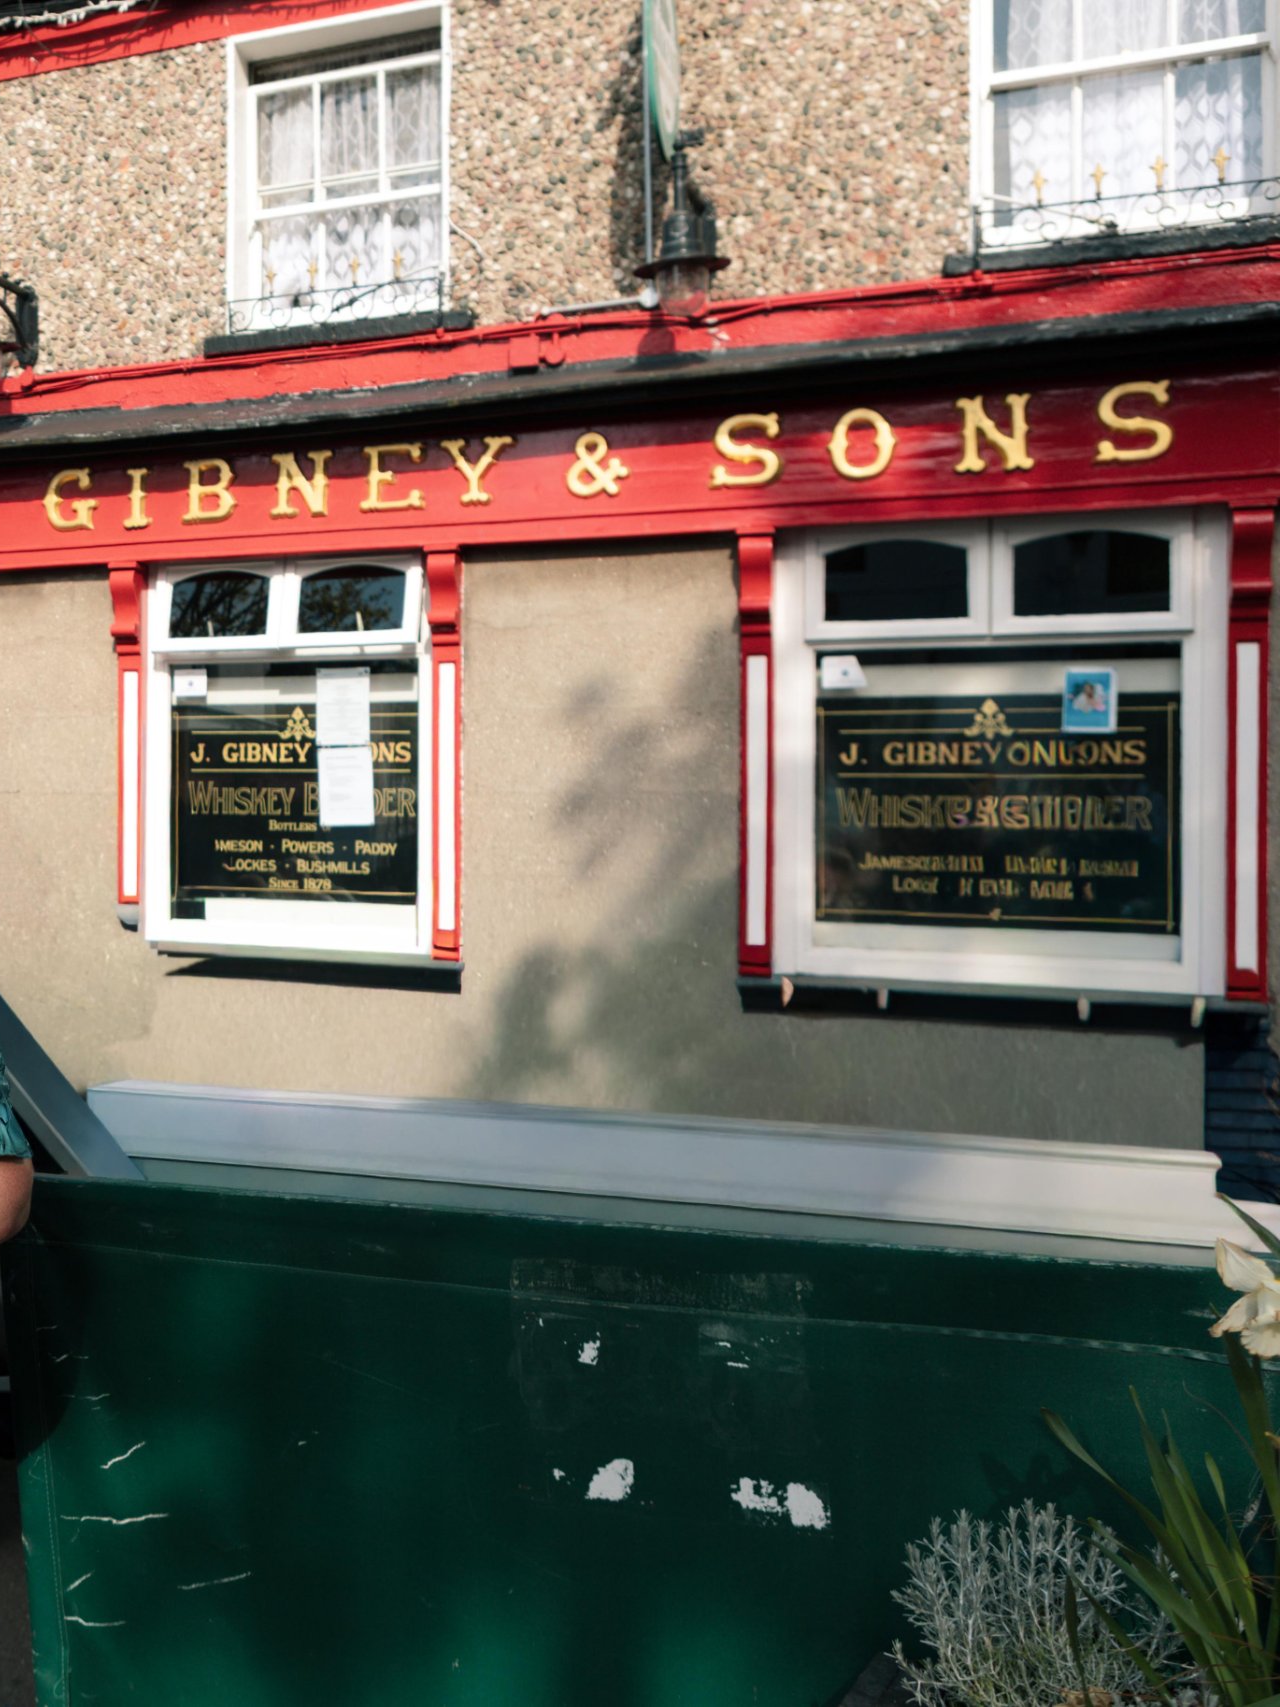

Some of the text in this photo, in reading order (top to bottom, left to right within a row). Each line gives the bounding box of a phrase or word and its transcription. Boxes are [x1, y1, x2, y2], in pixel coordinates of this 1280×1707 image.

[42, 435, 515, 531] GIBNEY
[566, 432, 631, 498] &
[709, 380, 1174, 488] SONS
[190, 742, 412, 763] J. GIBNEY ONS
[838, 743, 869, 766] J.
[882, 742, 1001, 766] GIBNEY
[188, 781, 295, 816] WHISKEY
[281, 838, 335, 854] POWERS
[354, 840, 397, 856] PADDY
[297, 859, 370, 875] BUSHMILLS
